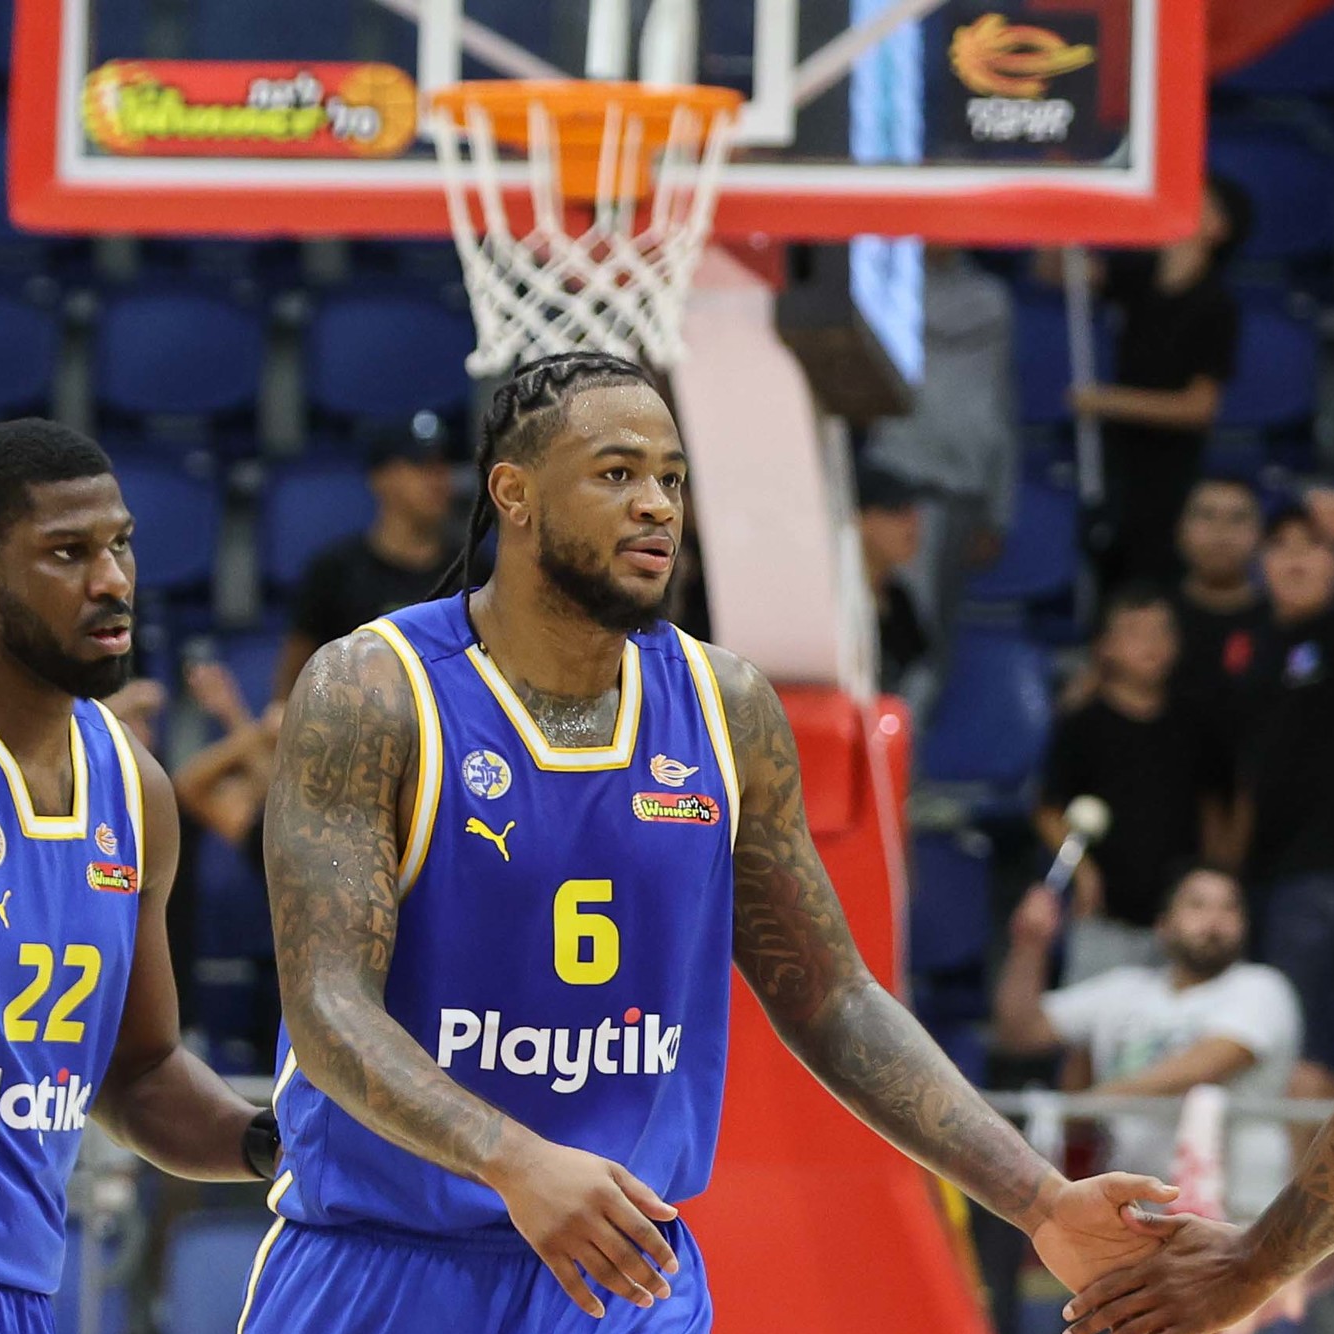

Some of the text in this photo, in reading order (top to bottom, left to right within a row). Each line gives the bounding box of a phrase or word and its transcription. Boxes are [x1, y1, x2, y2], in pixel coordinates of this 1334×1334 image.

[641, 799, 699, 818] Winner
[553, 879, 620, 986] 6
[3, 943, 102, 1042] 22
